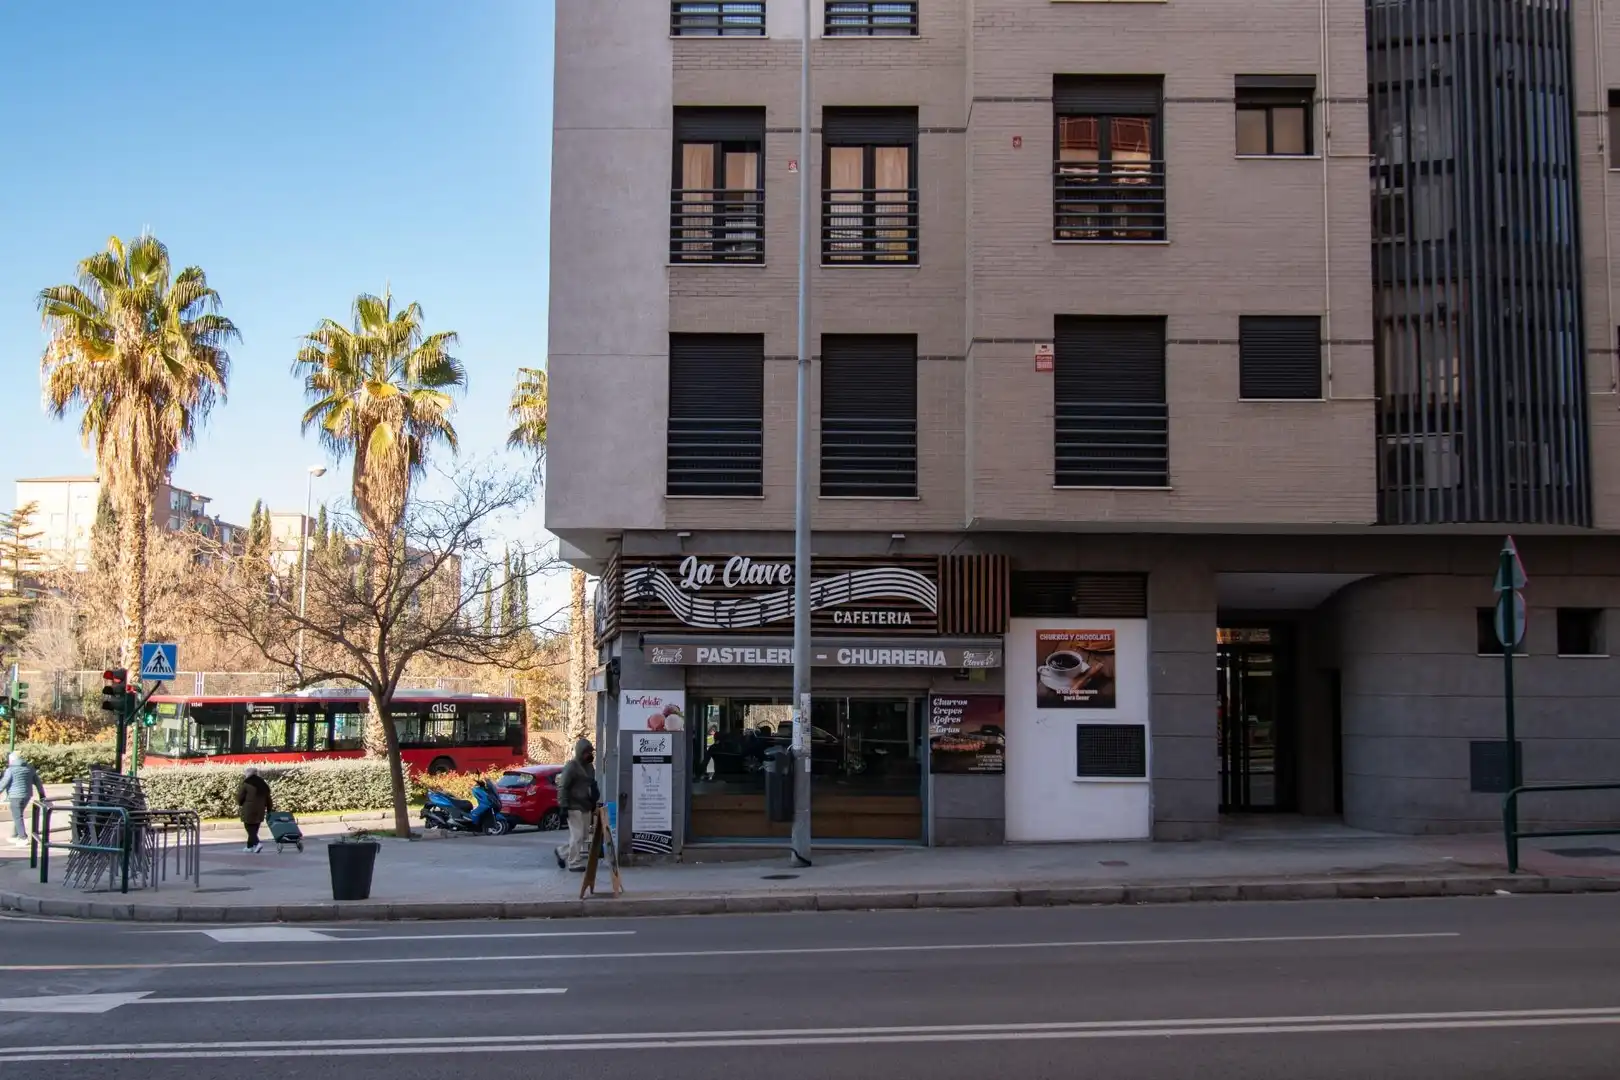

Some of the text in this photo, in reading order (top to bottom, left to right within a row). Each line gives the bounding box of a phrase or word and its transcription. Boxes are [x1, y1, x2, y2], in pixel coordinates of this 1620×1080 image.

[679, 555, 792, 590] La Clave
[834, 611, 912, 624] CAFETERIA
[1039, 633, 1111, 641] CHURROS Y CHOCOLATE
[696, 647, 795, 664] PASTELERI
[837, 648, 947, 666] CHURRERIA
[933, 698, 968, 706] Churros
[431, 702, 457, 713] alsa
[933, 706, 963, 716] Crepes
[933, 715, 961, 725] Gofres
[936, 725, 961, 733] Tartas
